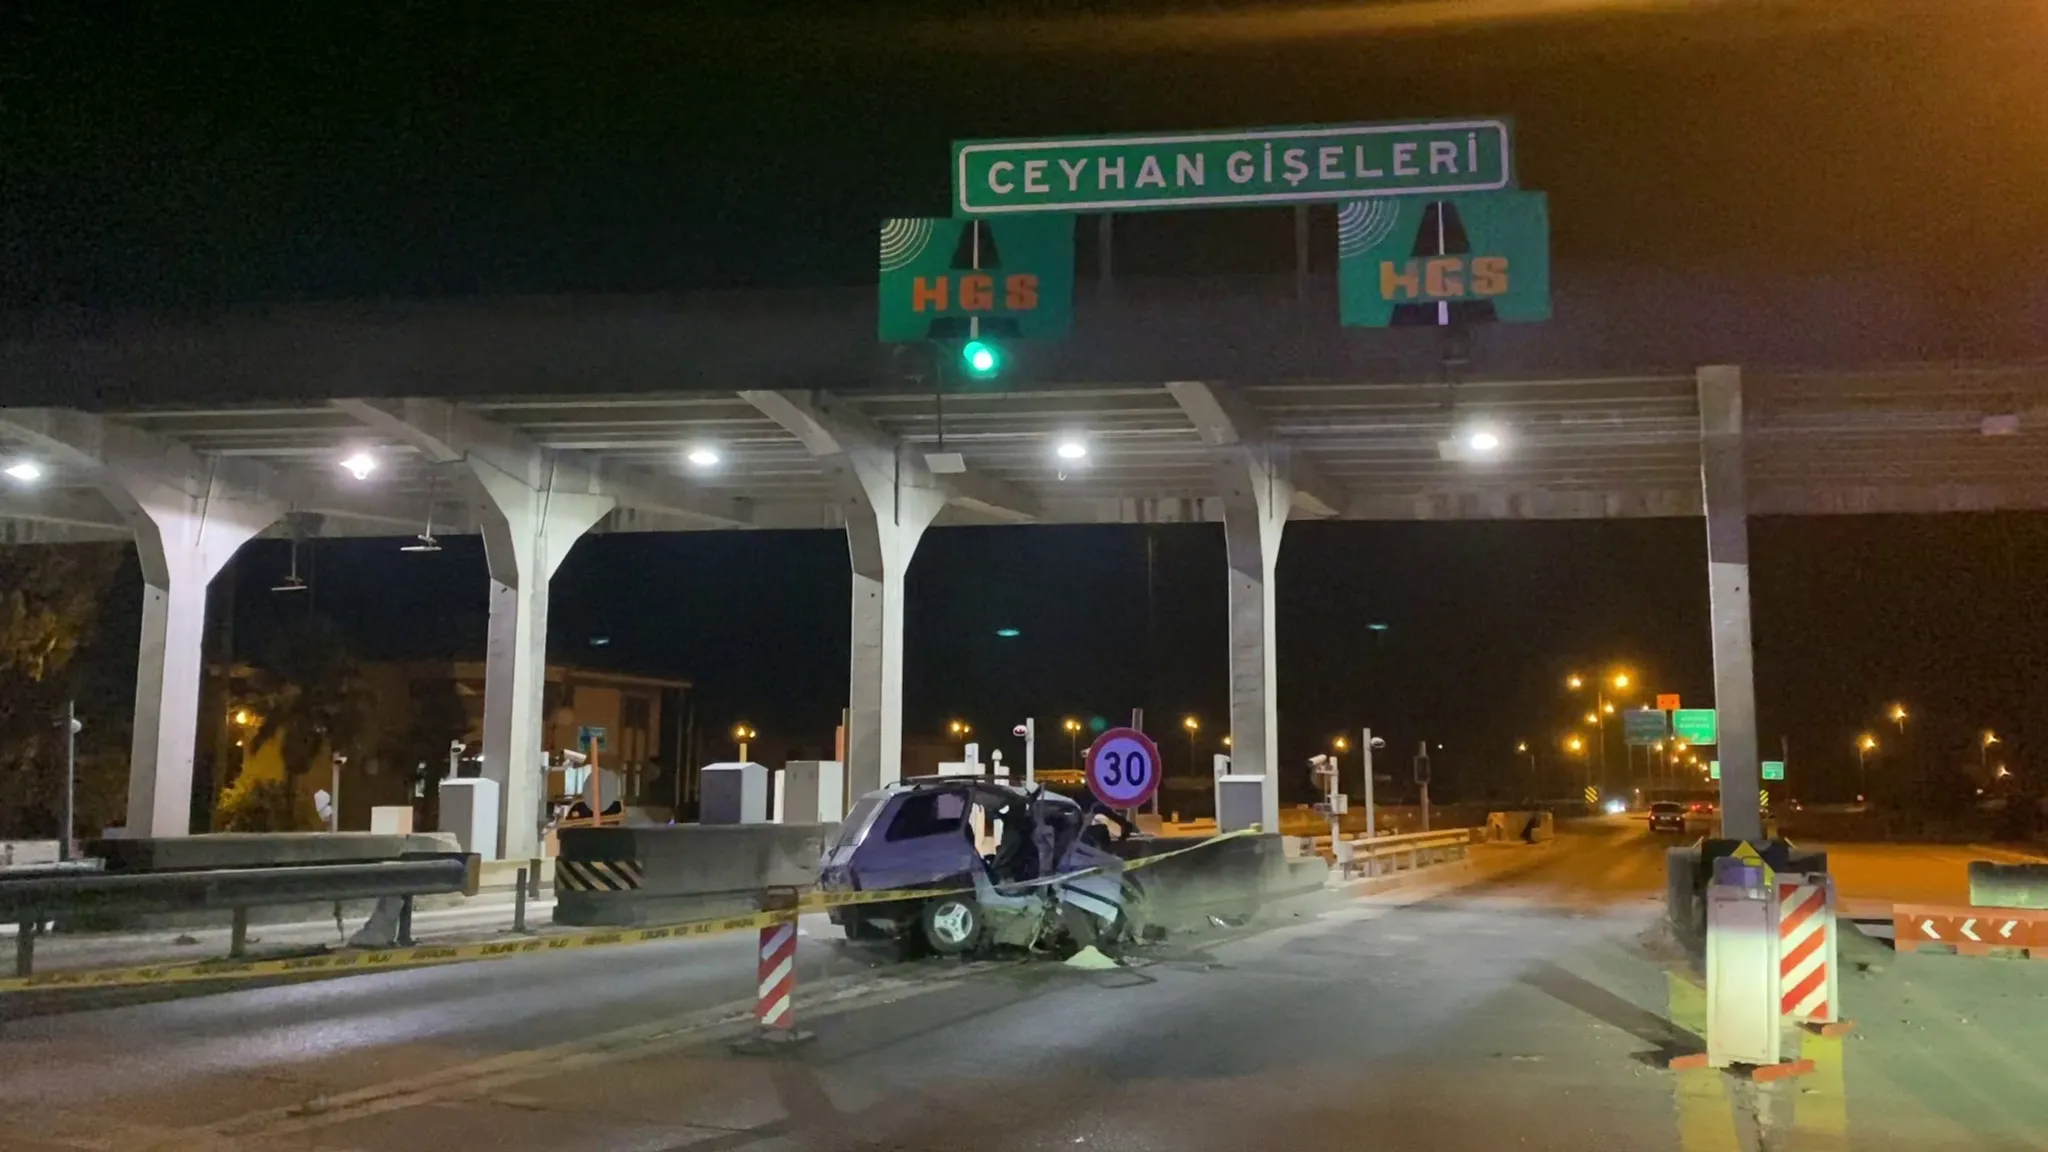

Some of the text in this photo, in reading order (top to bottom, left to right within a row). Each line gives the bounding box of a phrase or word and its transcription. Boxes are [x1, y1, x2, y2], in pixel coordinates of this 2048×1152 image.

[986, 132, 1478, 195] CEYHAN GİŞELERİ
[912, 274, 1038, 312] HGS
[1380, 257, 1508, 300] HGS
[1103, 750, 1146, 787] 30
